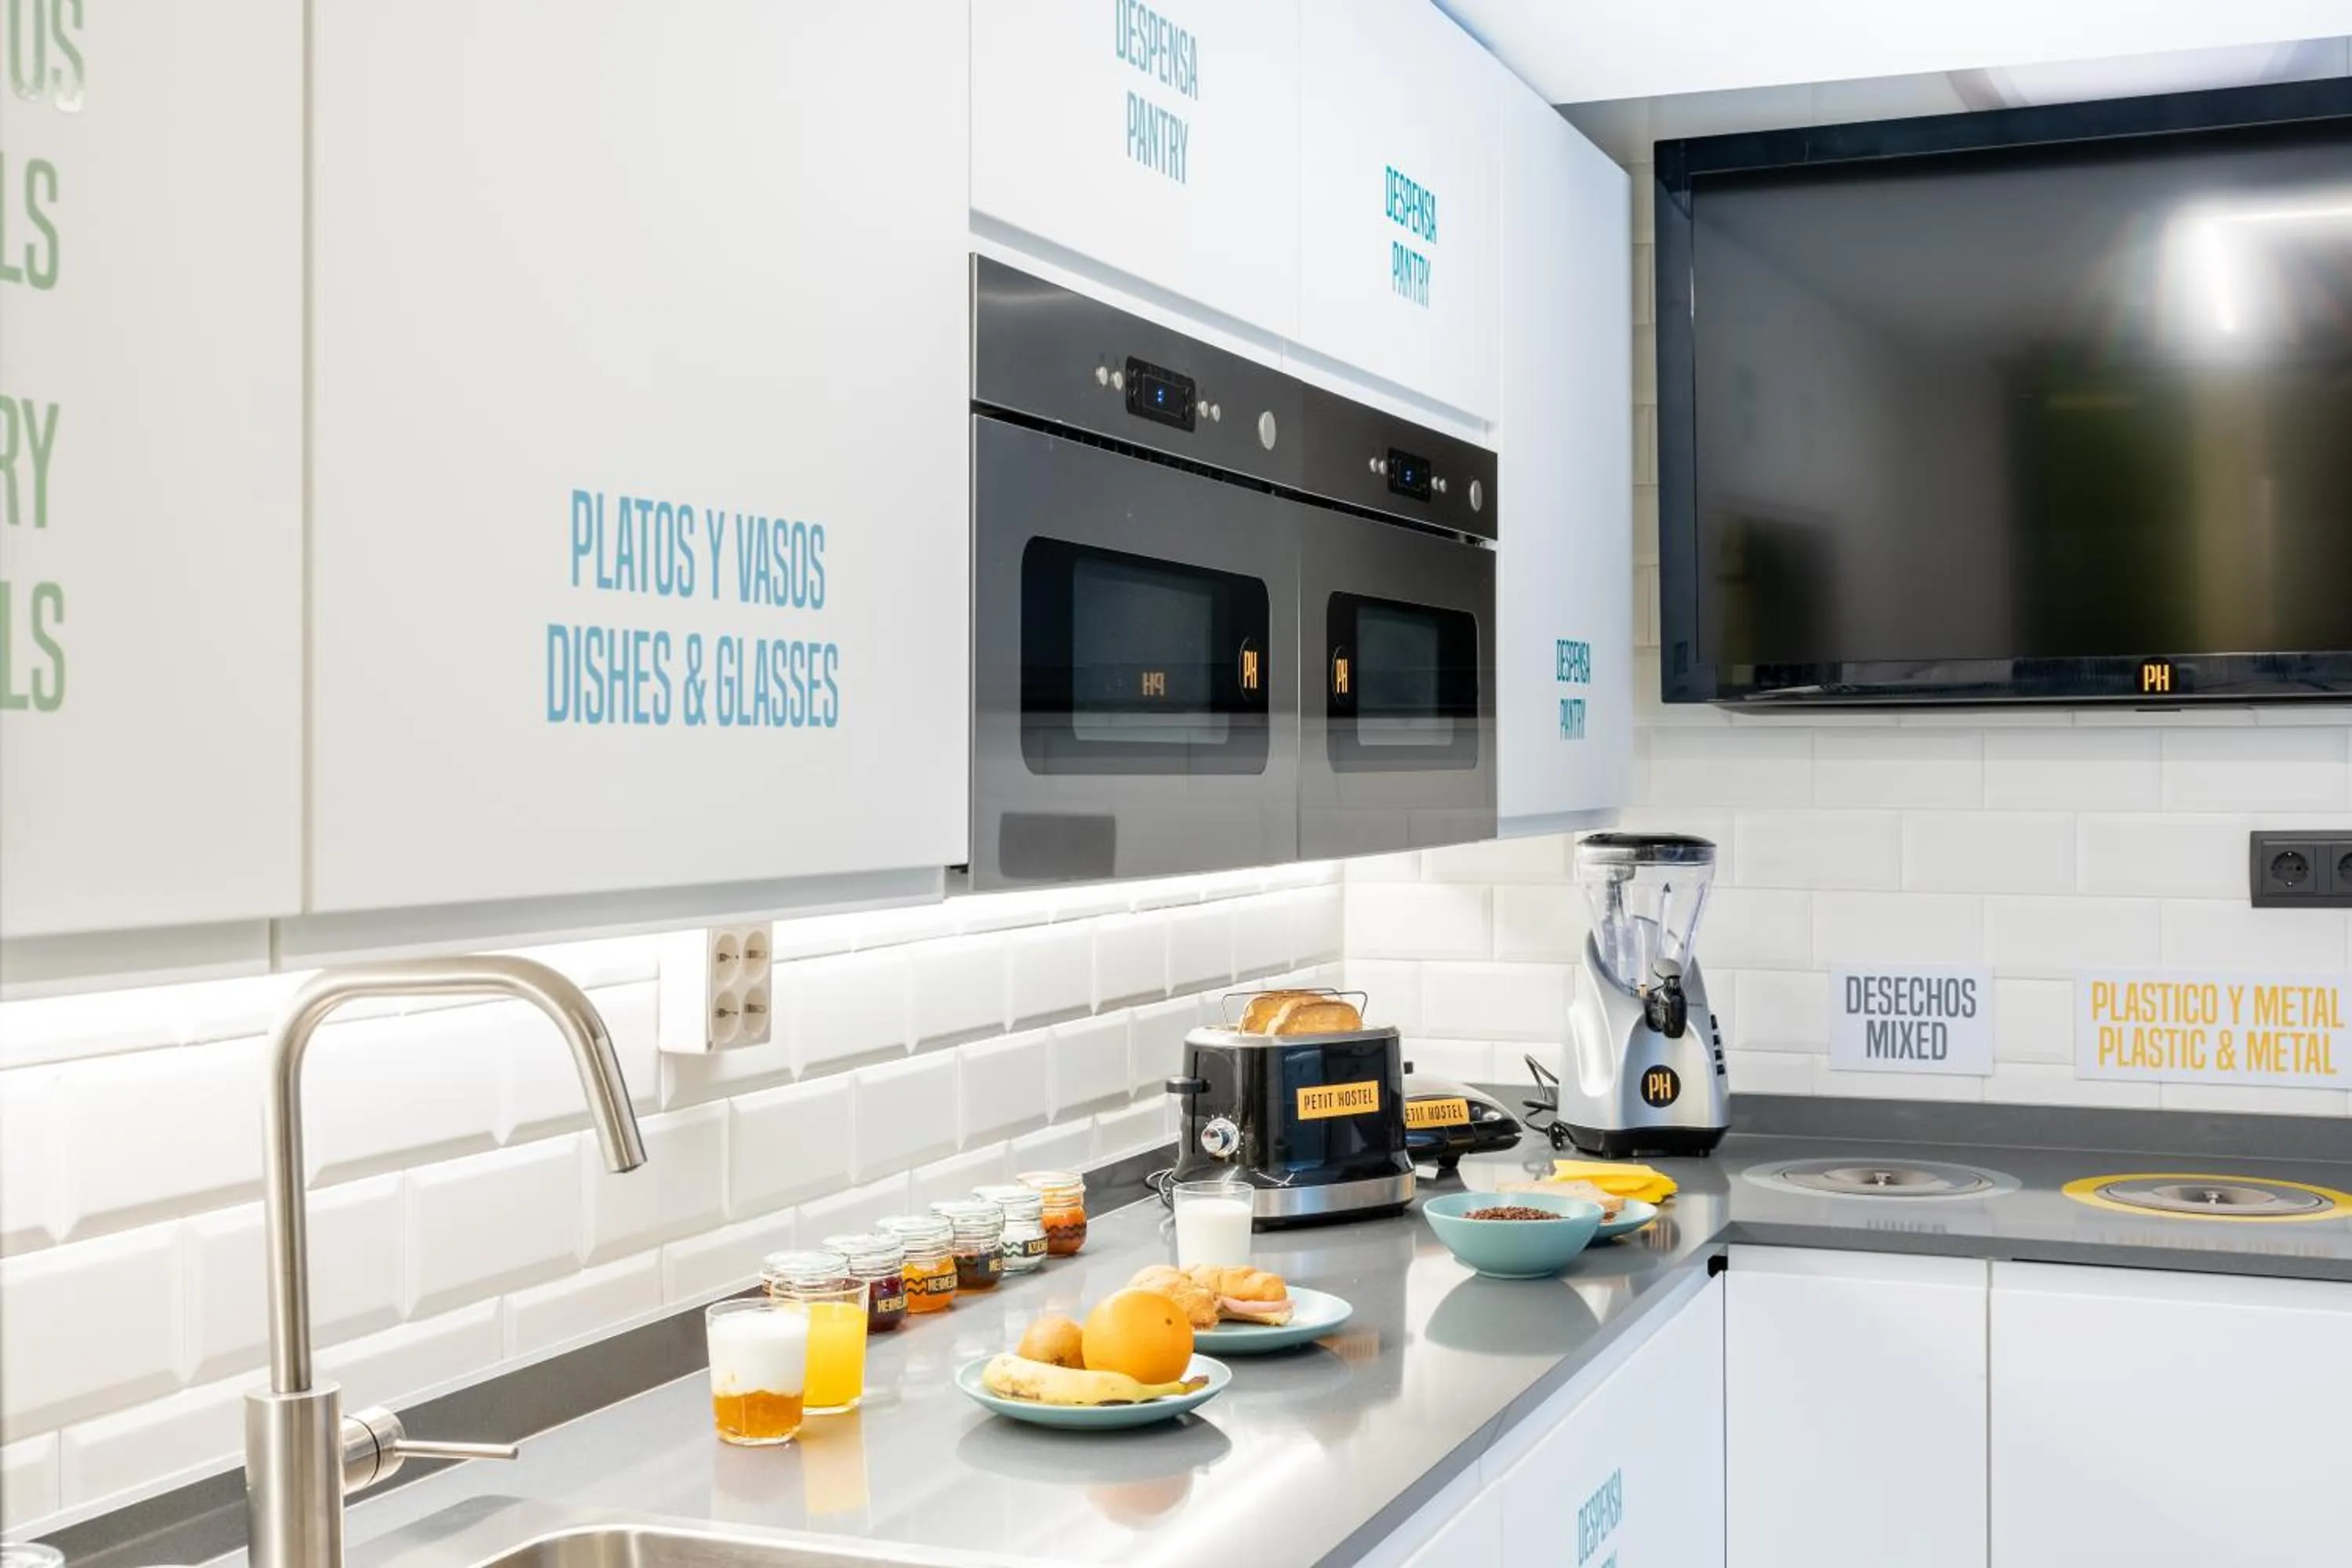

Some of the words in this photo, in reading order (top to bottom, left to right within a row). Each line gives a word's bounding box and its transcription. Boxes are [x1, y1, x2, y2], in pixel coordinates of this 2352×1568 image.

[1116, 0, 1198, 101] DESPENSA
[1127, 89, 1189, 185] PANTRY
[1385, 165, 1436, 245] DESPENSA
[1392, 240, 1431, 309] PANTRY
[572, 489, 695, 598] PLATOS
[706, 509, 726, 601] Y
[735, 514, 826, 610] VASOS
[546, 624, 672, 726] DISHES
[683, 633, 708, 727] &
[716, 636, 840, 728] GLASSES
[1243, 650, 1258, 689] PH
[1335, 659, 1348, 694] PH
[1556, 640, 1591, 684] DESPENSA
[2143, 664, 2169, 691] PH
[1559, 699, 1585, 741] PANTRY
[1846, 975, 1976, 1018] DESECHOS
[2092, 980, 2218, 1025] PLASTICO
[2227, 984, 2245, 1025] Y
[2253, 985, 2346, 1029] METAL
[1866, 1019, 1947, 1061] MIXED
[2098, 1026, 2207, 1069] PLASTIC
[2216, 1029, 2236, 1071] &
[2246, 1031, 2338, 1075] METAL
[1304, 1091, 1333, 1111] PETIT
[1338, 1087, 1374, 1106] HOSTEL
[1649, 1073, 1671, 1100] PH
[1405, 1106, 1425, 1123] ETIT
[1428, 1103, 1464, 1120] HOSTEL
[1578, 1467, 1622, 1568] DESPENSA
